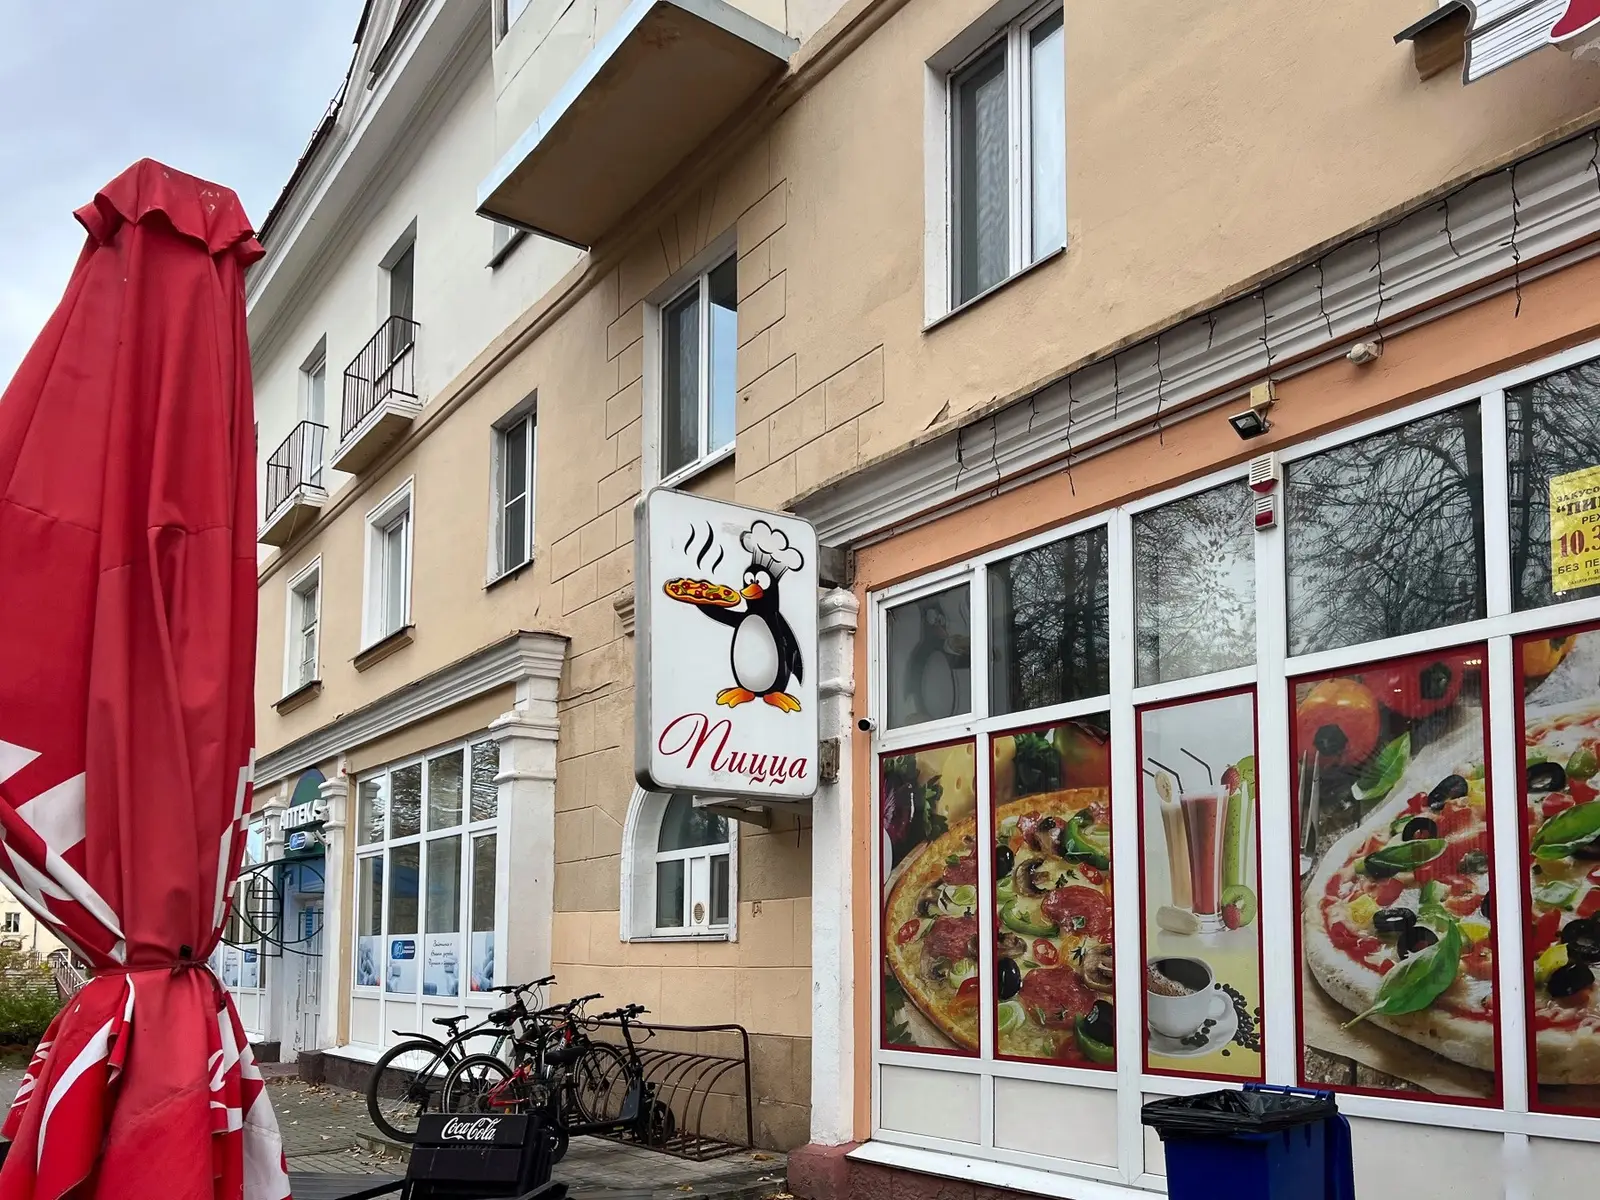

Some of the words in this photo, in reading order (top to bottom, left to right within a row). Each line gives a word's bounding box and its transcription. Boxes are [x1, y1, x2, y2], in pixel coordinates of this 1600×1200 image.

[1558, 562, 1579, 575] БЕЗ
[658, 712, 808, 787] Пицца
[441, 1116, 502, 1141] Coca-Cola
